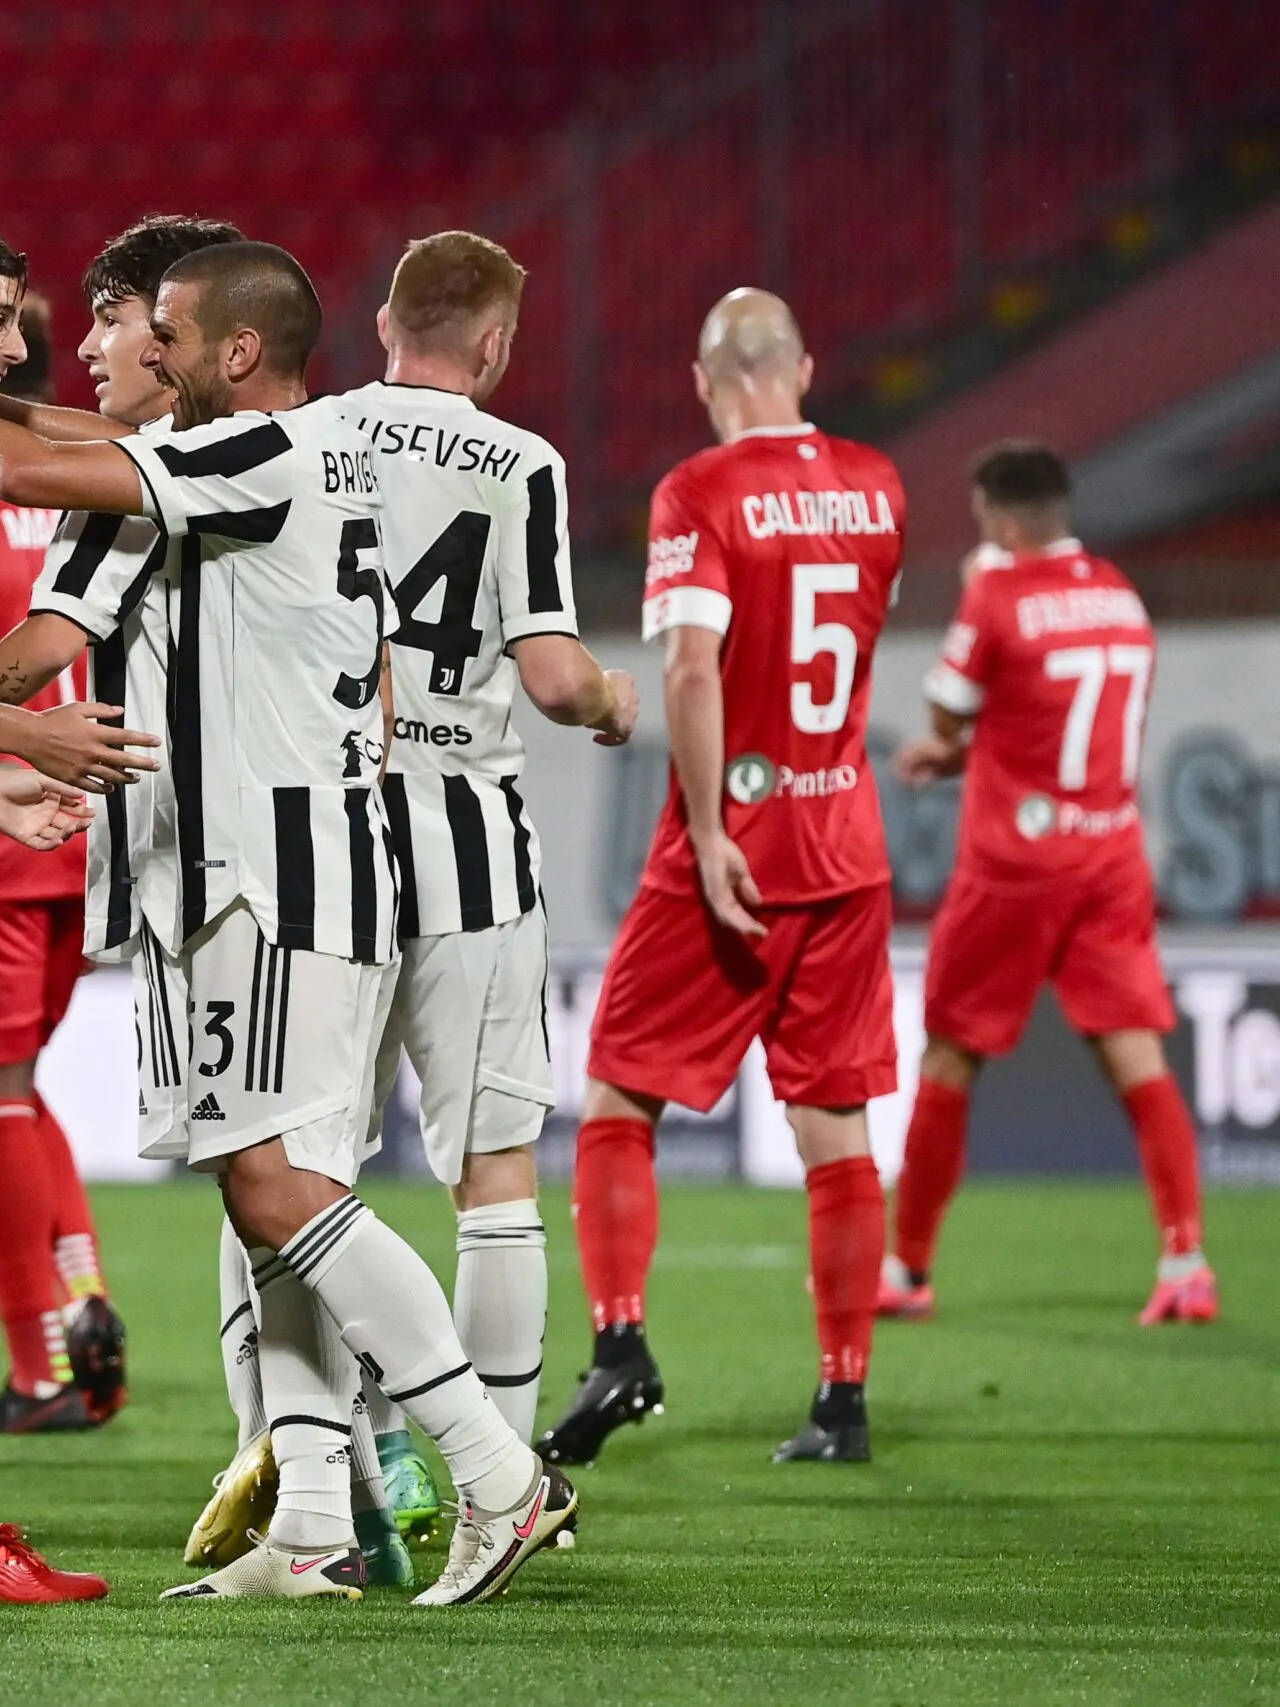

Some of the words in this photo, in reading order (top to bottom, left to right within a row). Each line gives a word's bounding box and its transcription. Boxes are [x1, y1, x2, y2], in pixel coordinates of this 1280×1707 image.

[742, 490, 897, 540] CALDIROLA
[332, 517, 384, 711] 5
[789, 562, 860, 735] 5
[1044, 645, 1153, 791] 77
[187, 1000, 235, 1078] 3
[191, 1111, 226, 1121] adidas
